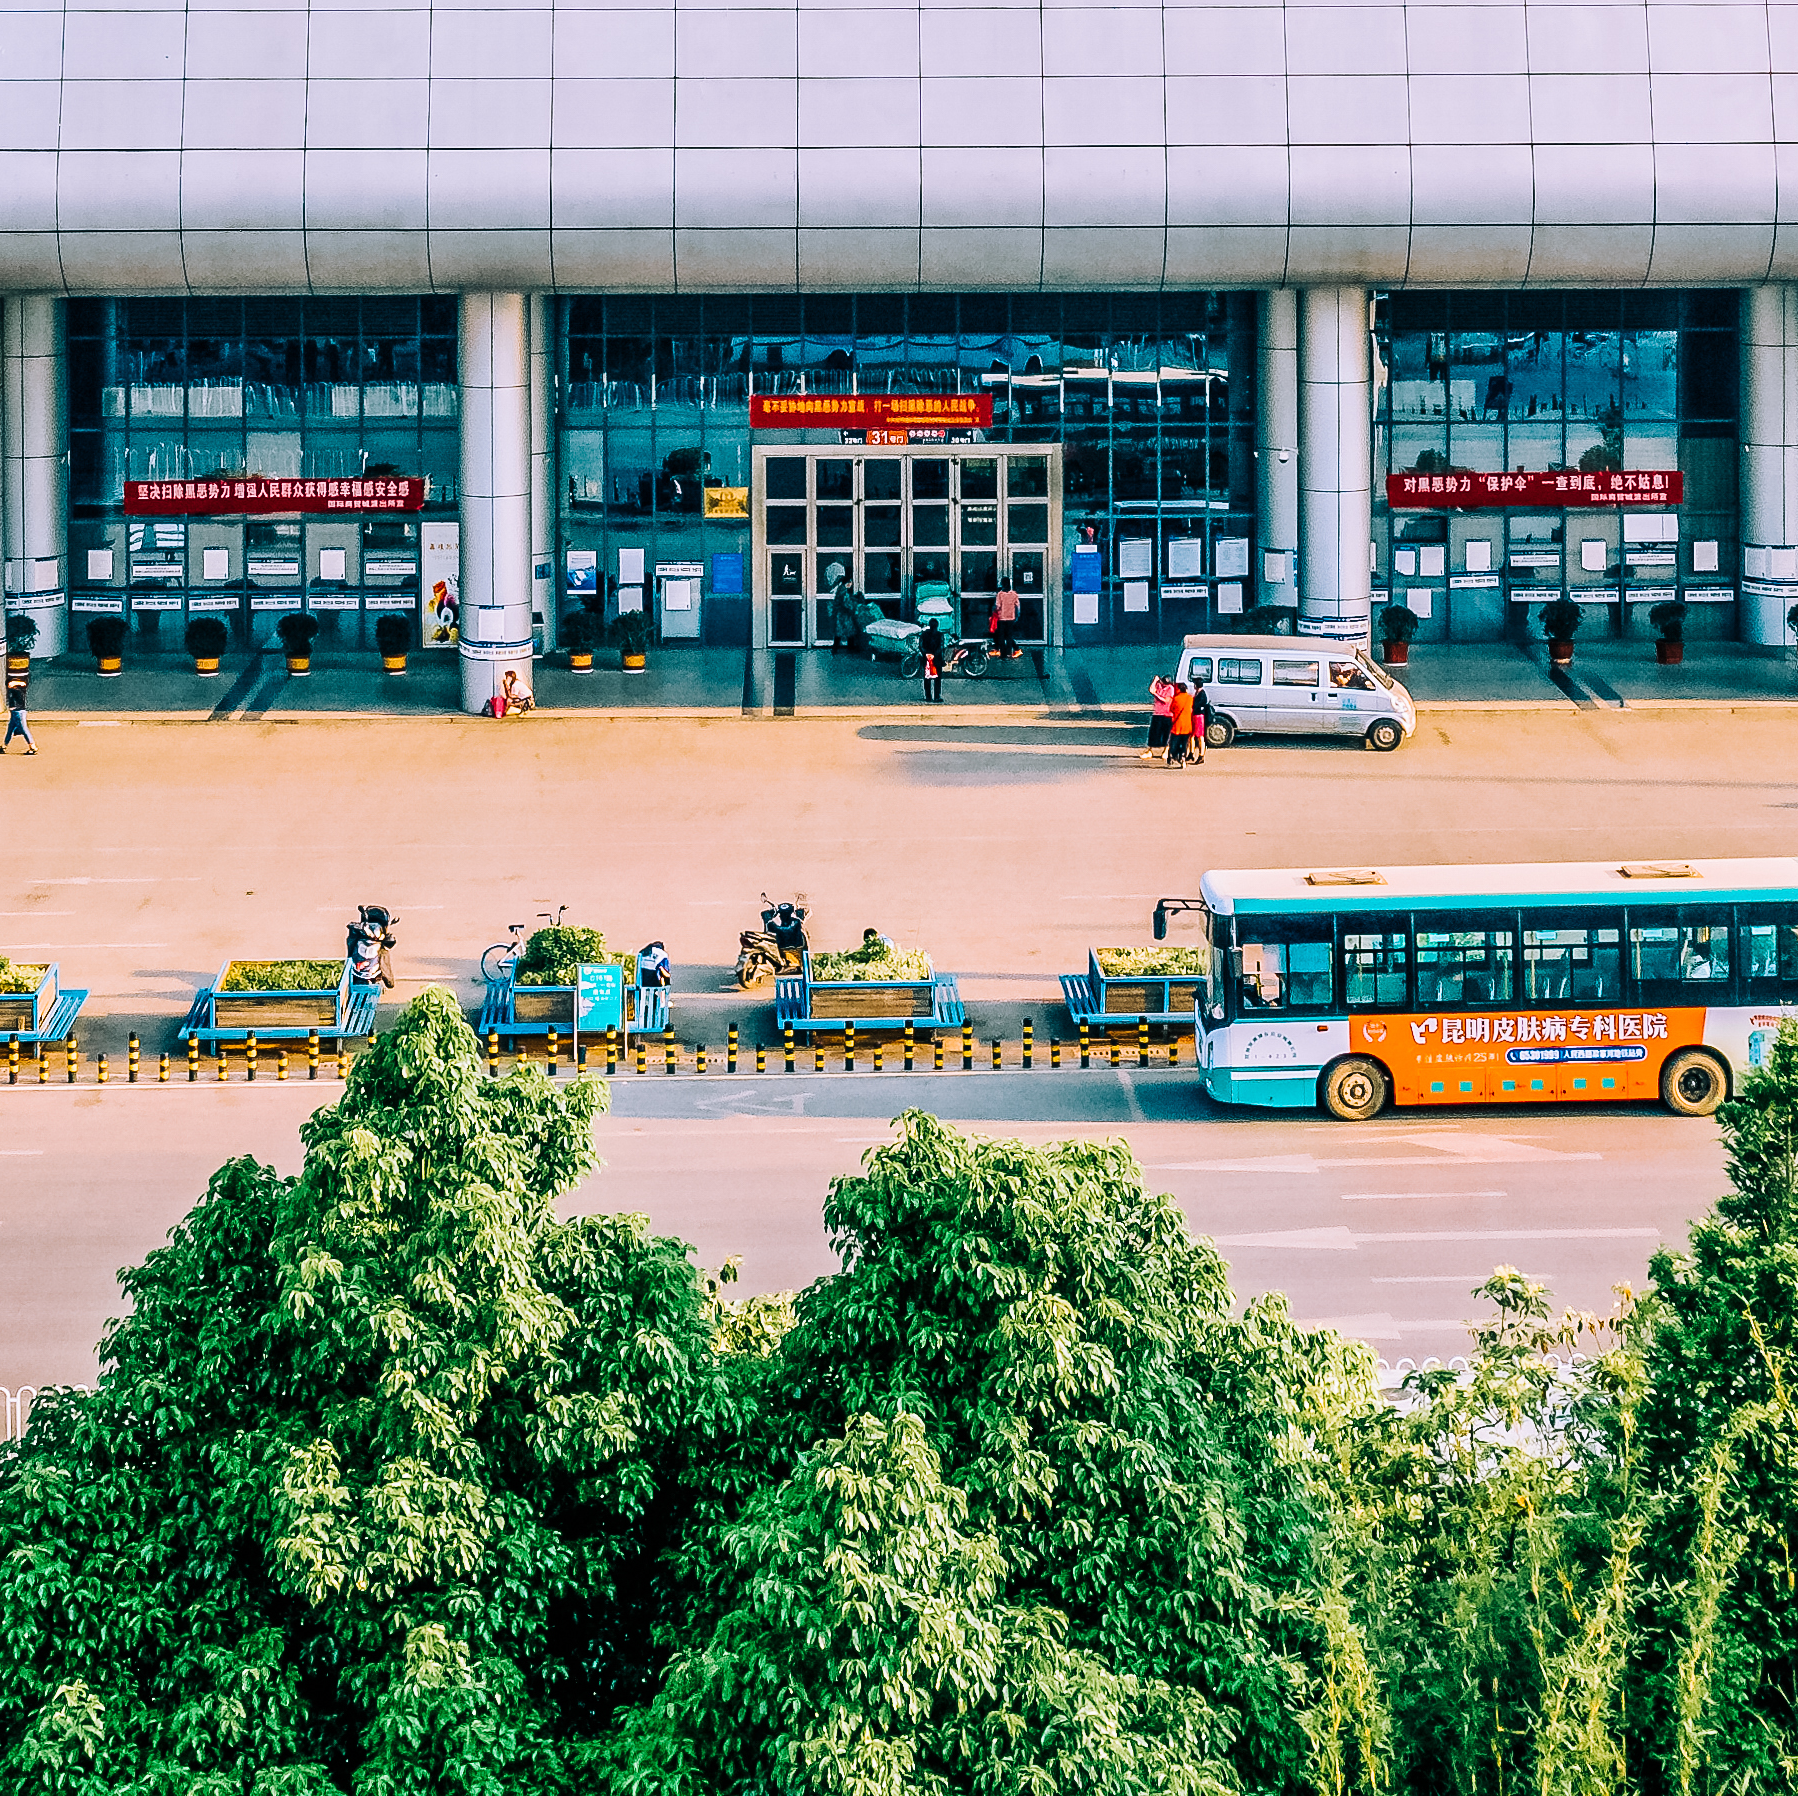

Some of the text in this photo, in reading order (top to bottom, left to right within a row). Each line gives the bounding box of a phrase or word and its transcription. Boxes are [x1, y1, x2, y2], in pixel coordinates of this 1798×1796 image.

[1441, 1013, 1669, 1045] 昆明皮肤病专科医院
